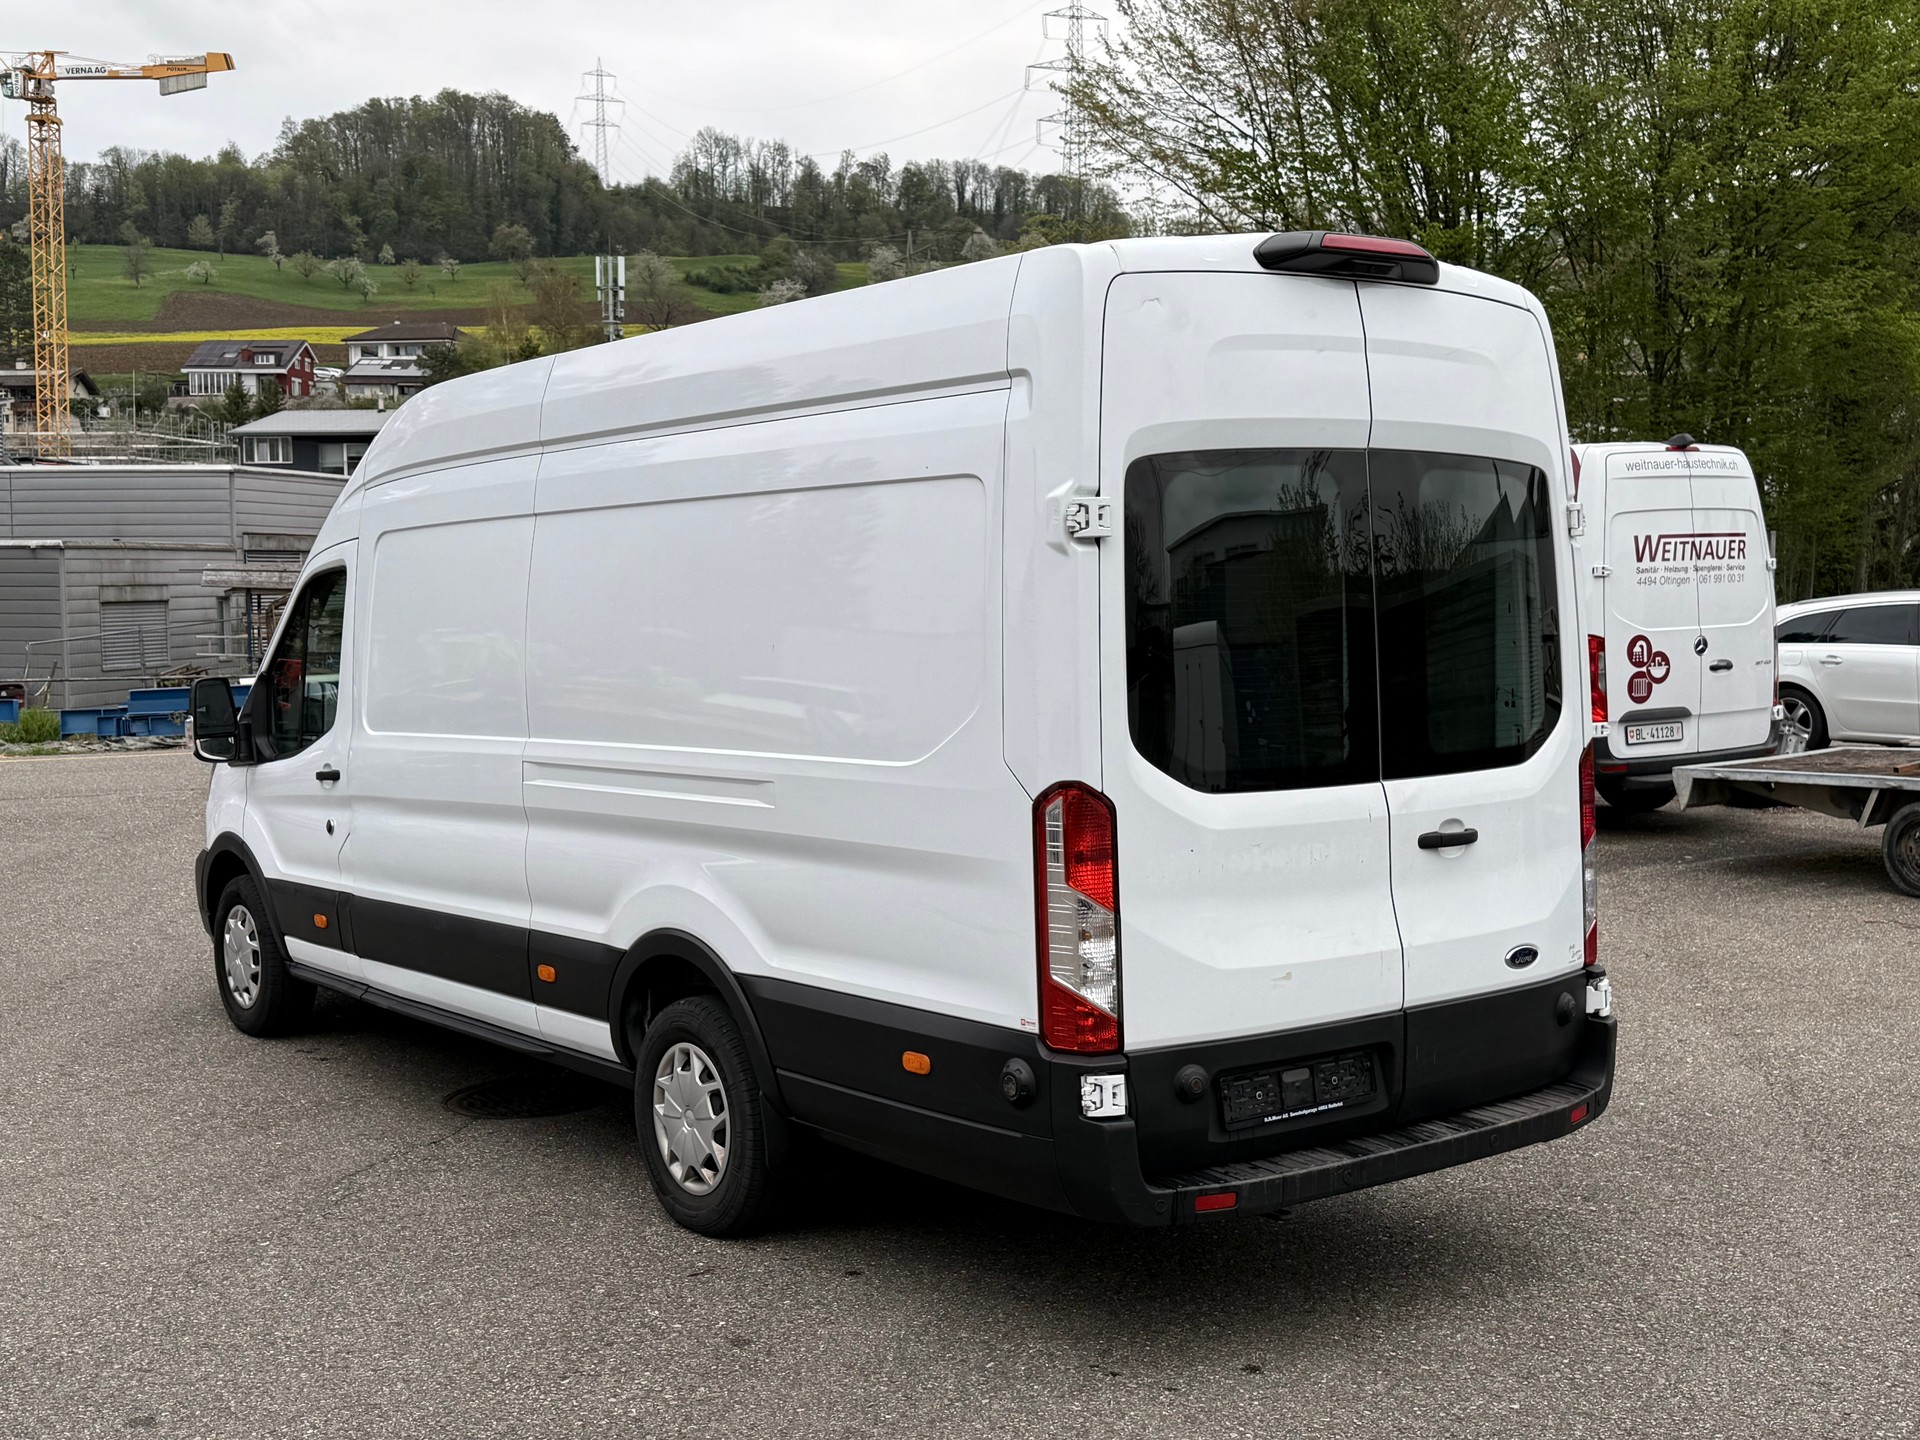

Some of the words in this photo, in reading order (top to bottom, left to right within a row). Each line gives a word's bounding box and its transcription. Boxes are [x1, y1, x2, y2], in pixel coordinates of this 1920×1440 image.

[65, 67, 93, 75] VERNA
[94, 66, 107, 74] AG
[1625, 457, 1739, 472] weitnauer-haustechnik.ch
[1633, 532, 1747, 563] WEITNAUER
[1636, 566, 1659, 575] Sanitär
[1664, 565, 1689, 574] Heizung
[1692, 564, 1722, 573] Spenglerei
[1726, 563, 1746, 572] Service
[1637, 576, 1657, 586] 4494
[1660, 575, 1690, 587] Oltingen
[1699, 574, 1712, 584] 061
[1713, 574, 1726, 583] 991
[1727, 573, 1736, 583] 00
[1737, 573, 1744, 583] 31
